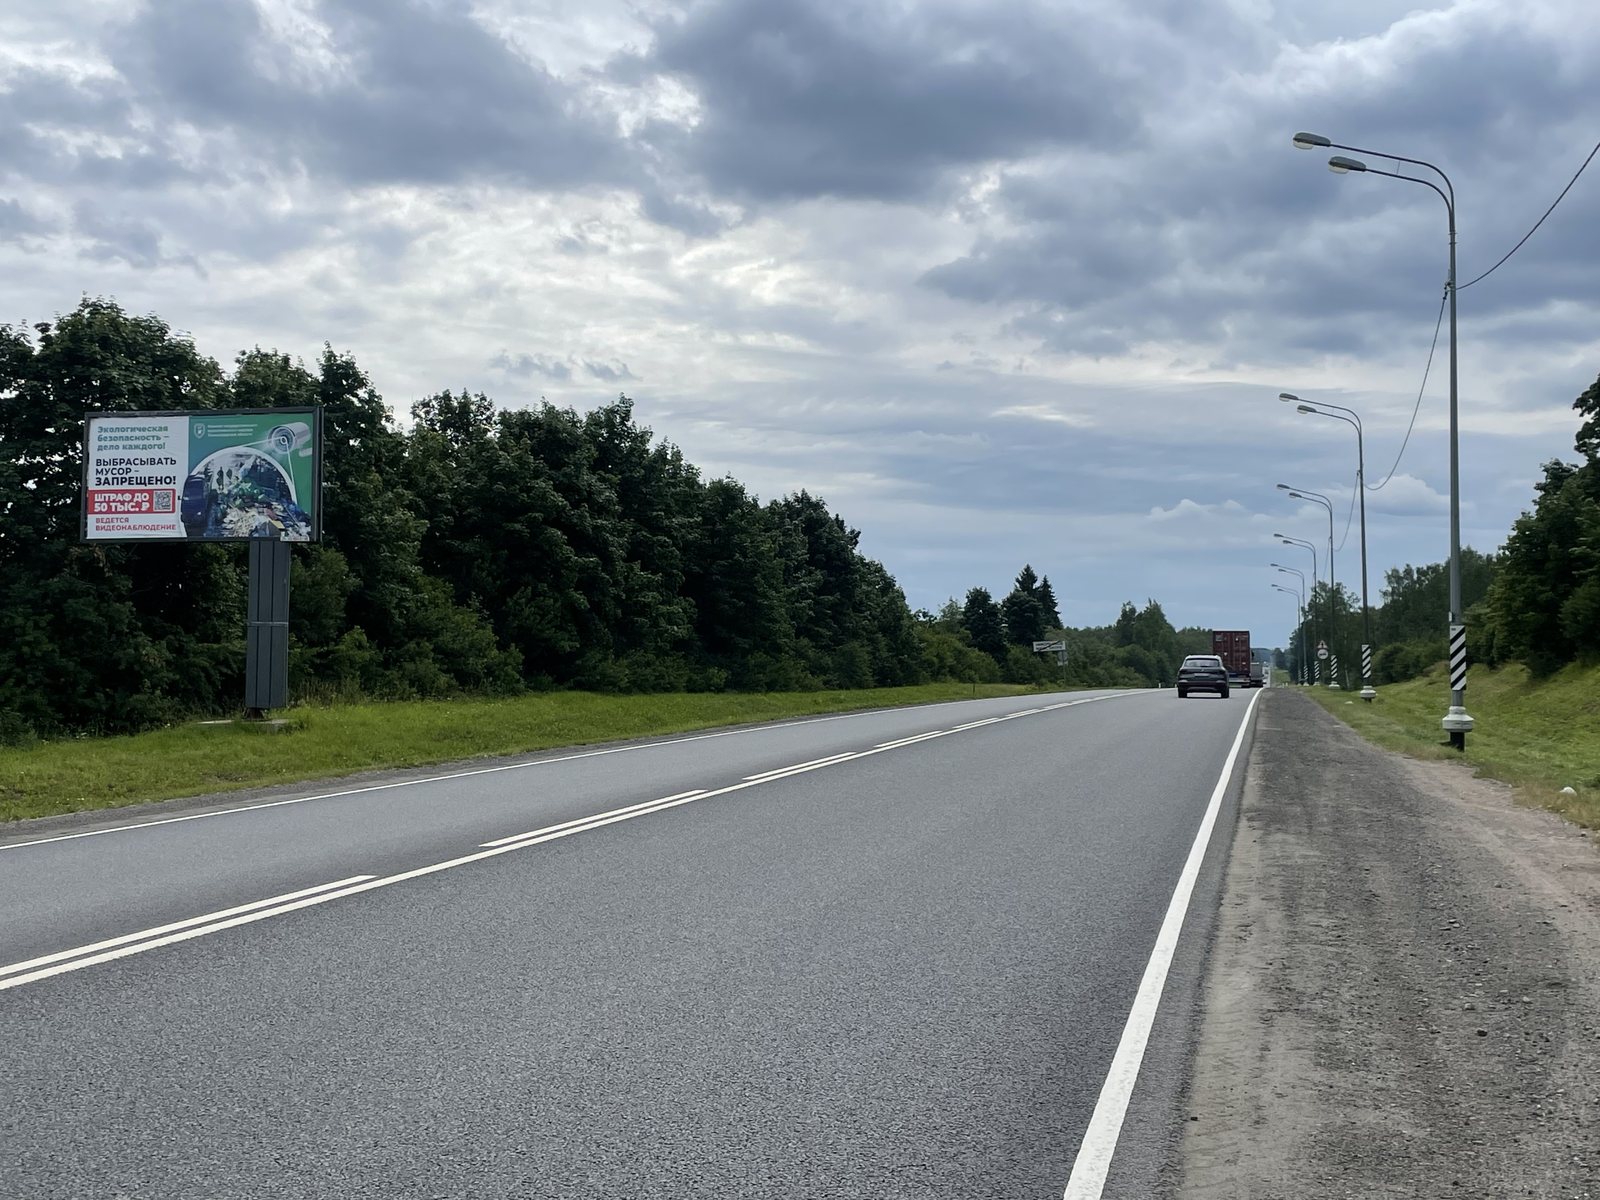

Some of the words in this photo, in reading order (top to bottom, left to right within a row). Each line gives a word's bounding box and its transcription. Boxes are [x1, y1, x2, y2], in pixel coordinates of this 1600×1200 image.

[122, 442, 166, 450] каждого!
[96, 457, 176, 466] ВЫБРАСЫВАТЬ
[96, 468, 132, 476] МУСОР
[95, 476, 176, 486] ЗАПРЕЩЕНО!
[94, 493, 132, 502] ШТРАФ
[134, 493, 150, 502] ДО
[94, 502, 108, 512] 50
[110, 502, 139, 512] ТЫС.
